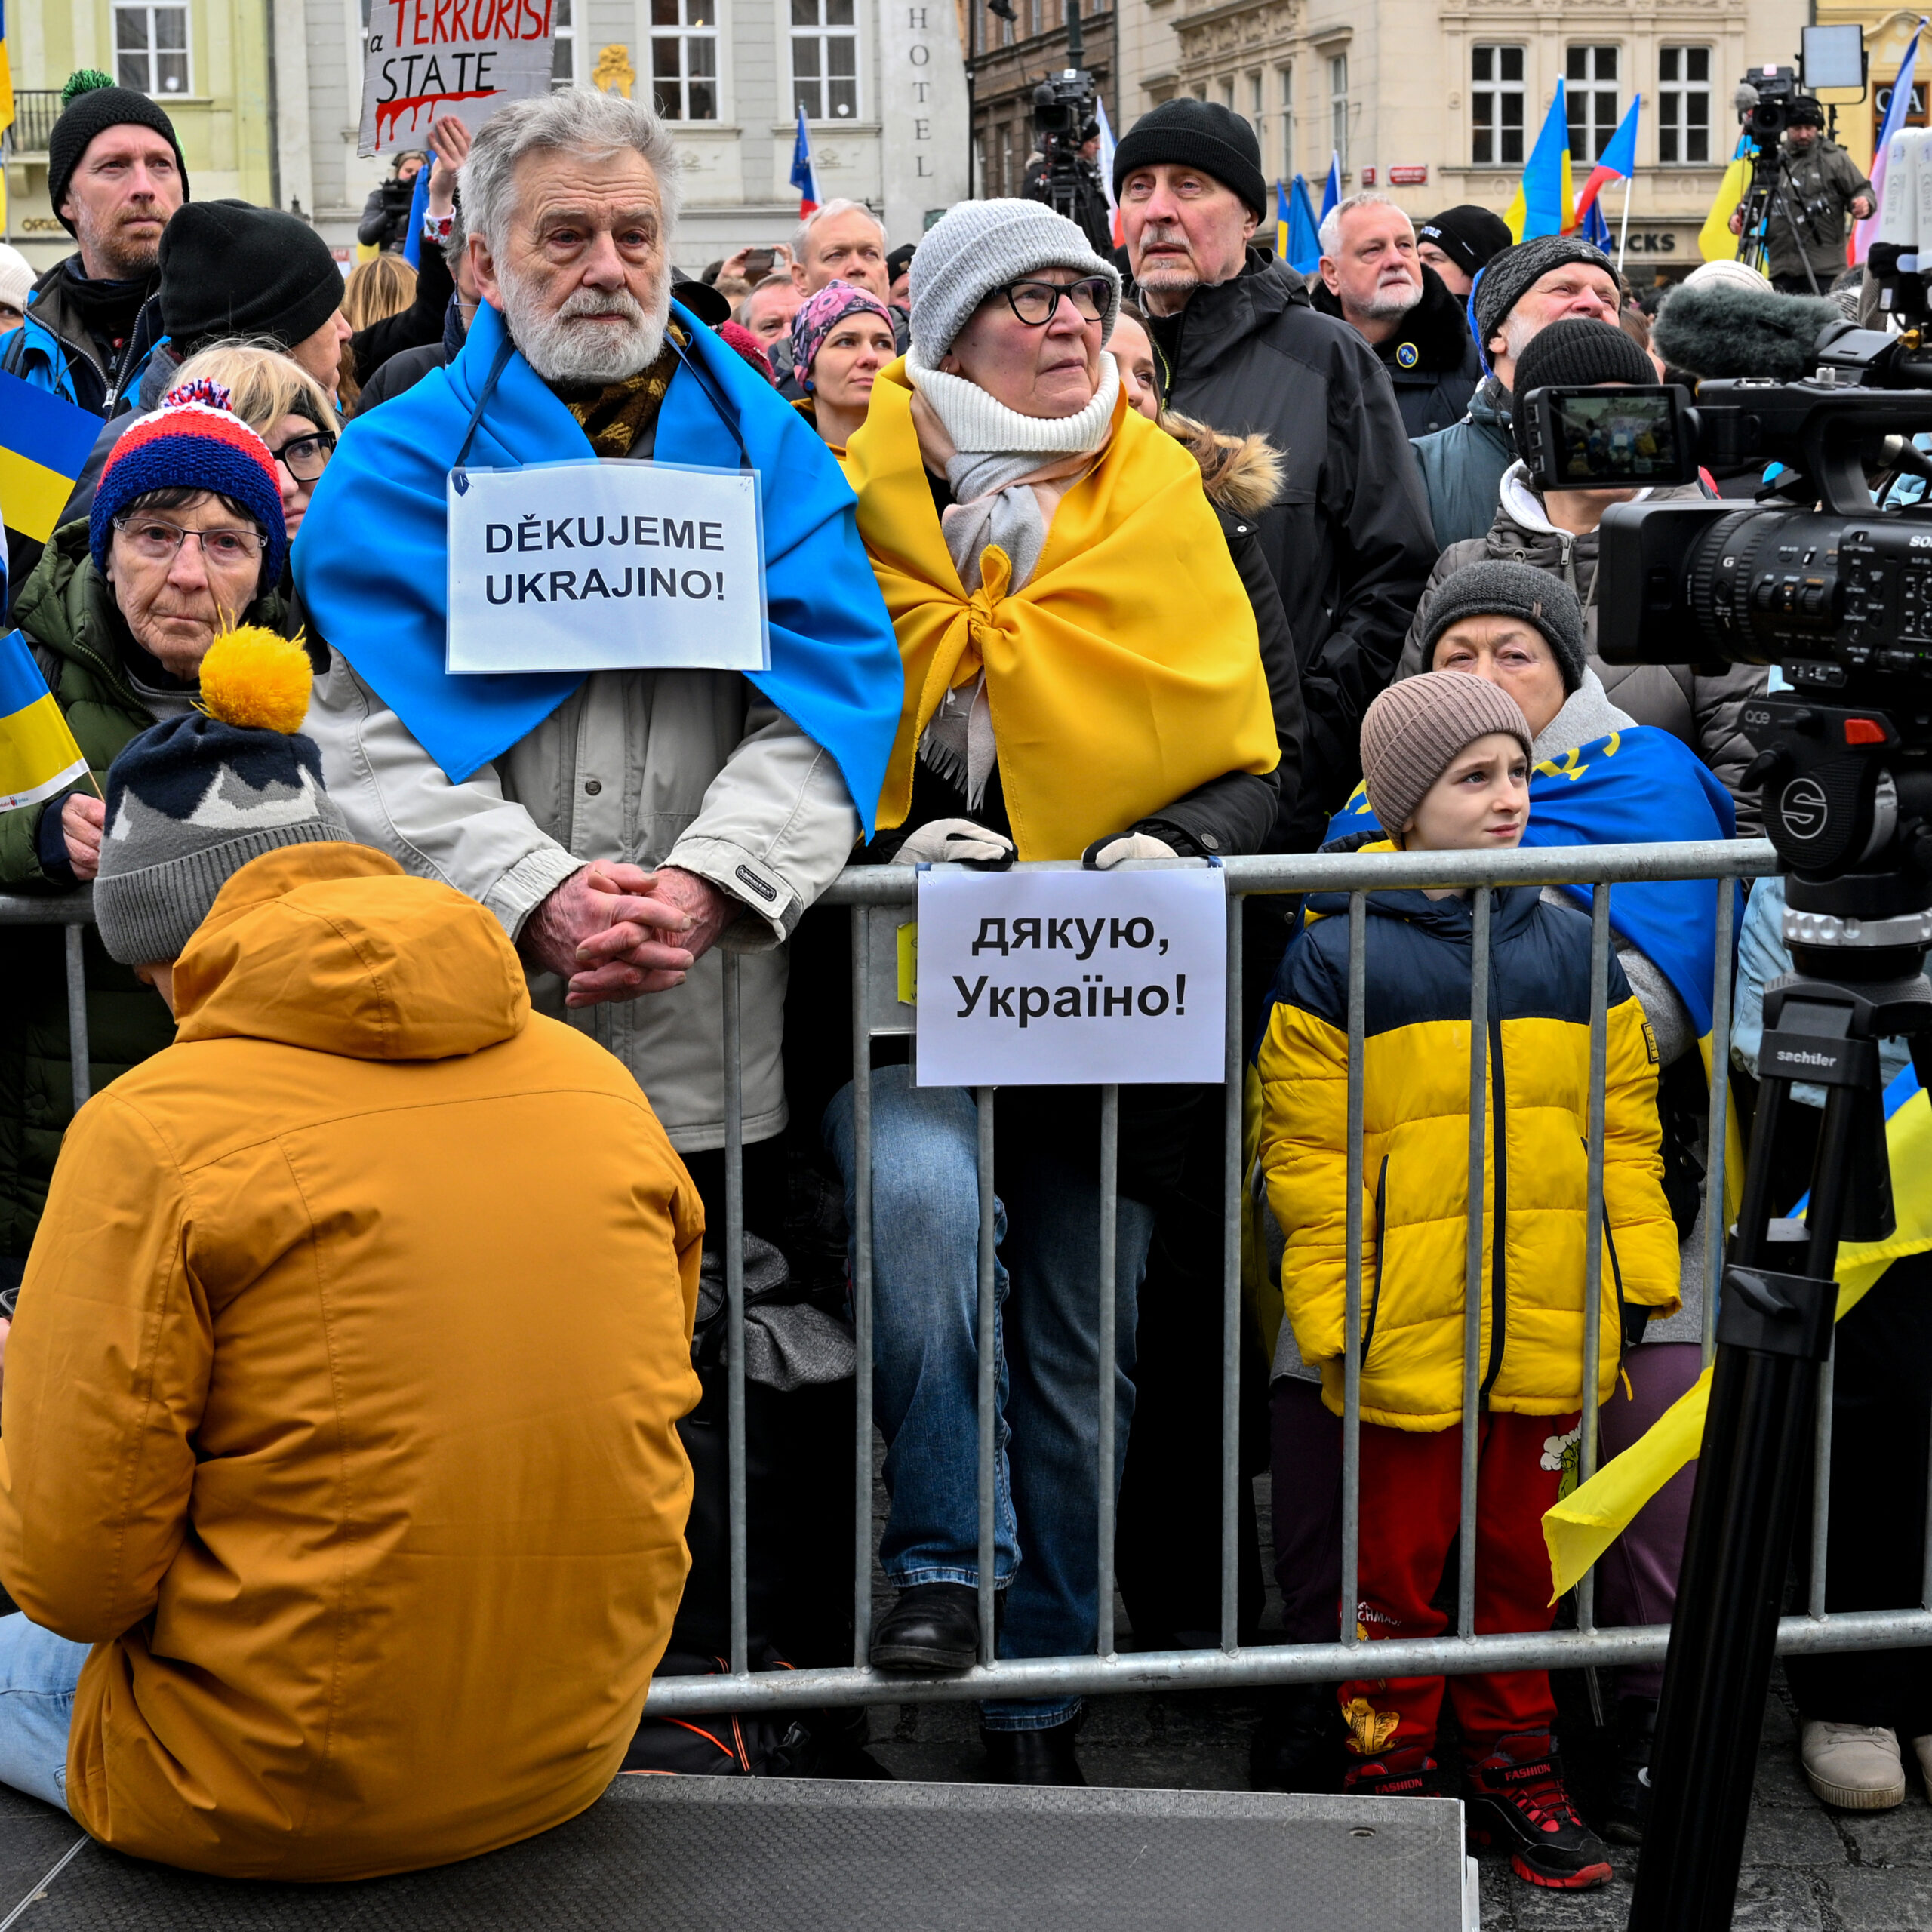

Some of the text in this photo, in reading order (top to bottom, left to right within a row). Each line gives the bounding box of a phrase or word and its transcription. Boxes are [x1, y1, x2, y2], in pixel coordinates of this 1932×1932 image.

[370, 35, 383, 53] a
[376, 52, 497, 103] STATE
[909, 8, 934, 177] HOTEL
[486, 513, 724, 553] DĚKUJEME
[1909, 535, 1932, 548] SO
[486, 567, 724, 605] UKRAJINO!
[1745, 710, 1770, 724] ace
[972, 917, 1168, 960] дякую,
[952, 974, 1186, 1028] Україно!
[1777, 1051, 1837, 1066] sachtler
[1375, 1777, 1423, 1795] FASHION
[1504, 1763, 1551, 1781] FASHION
